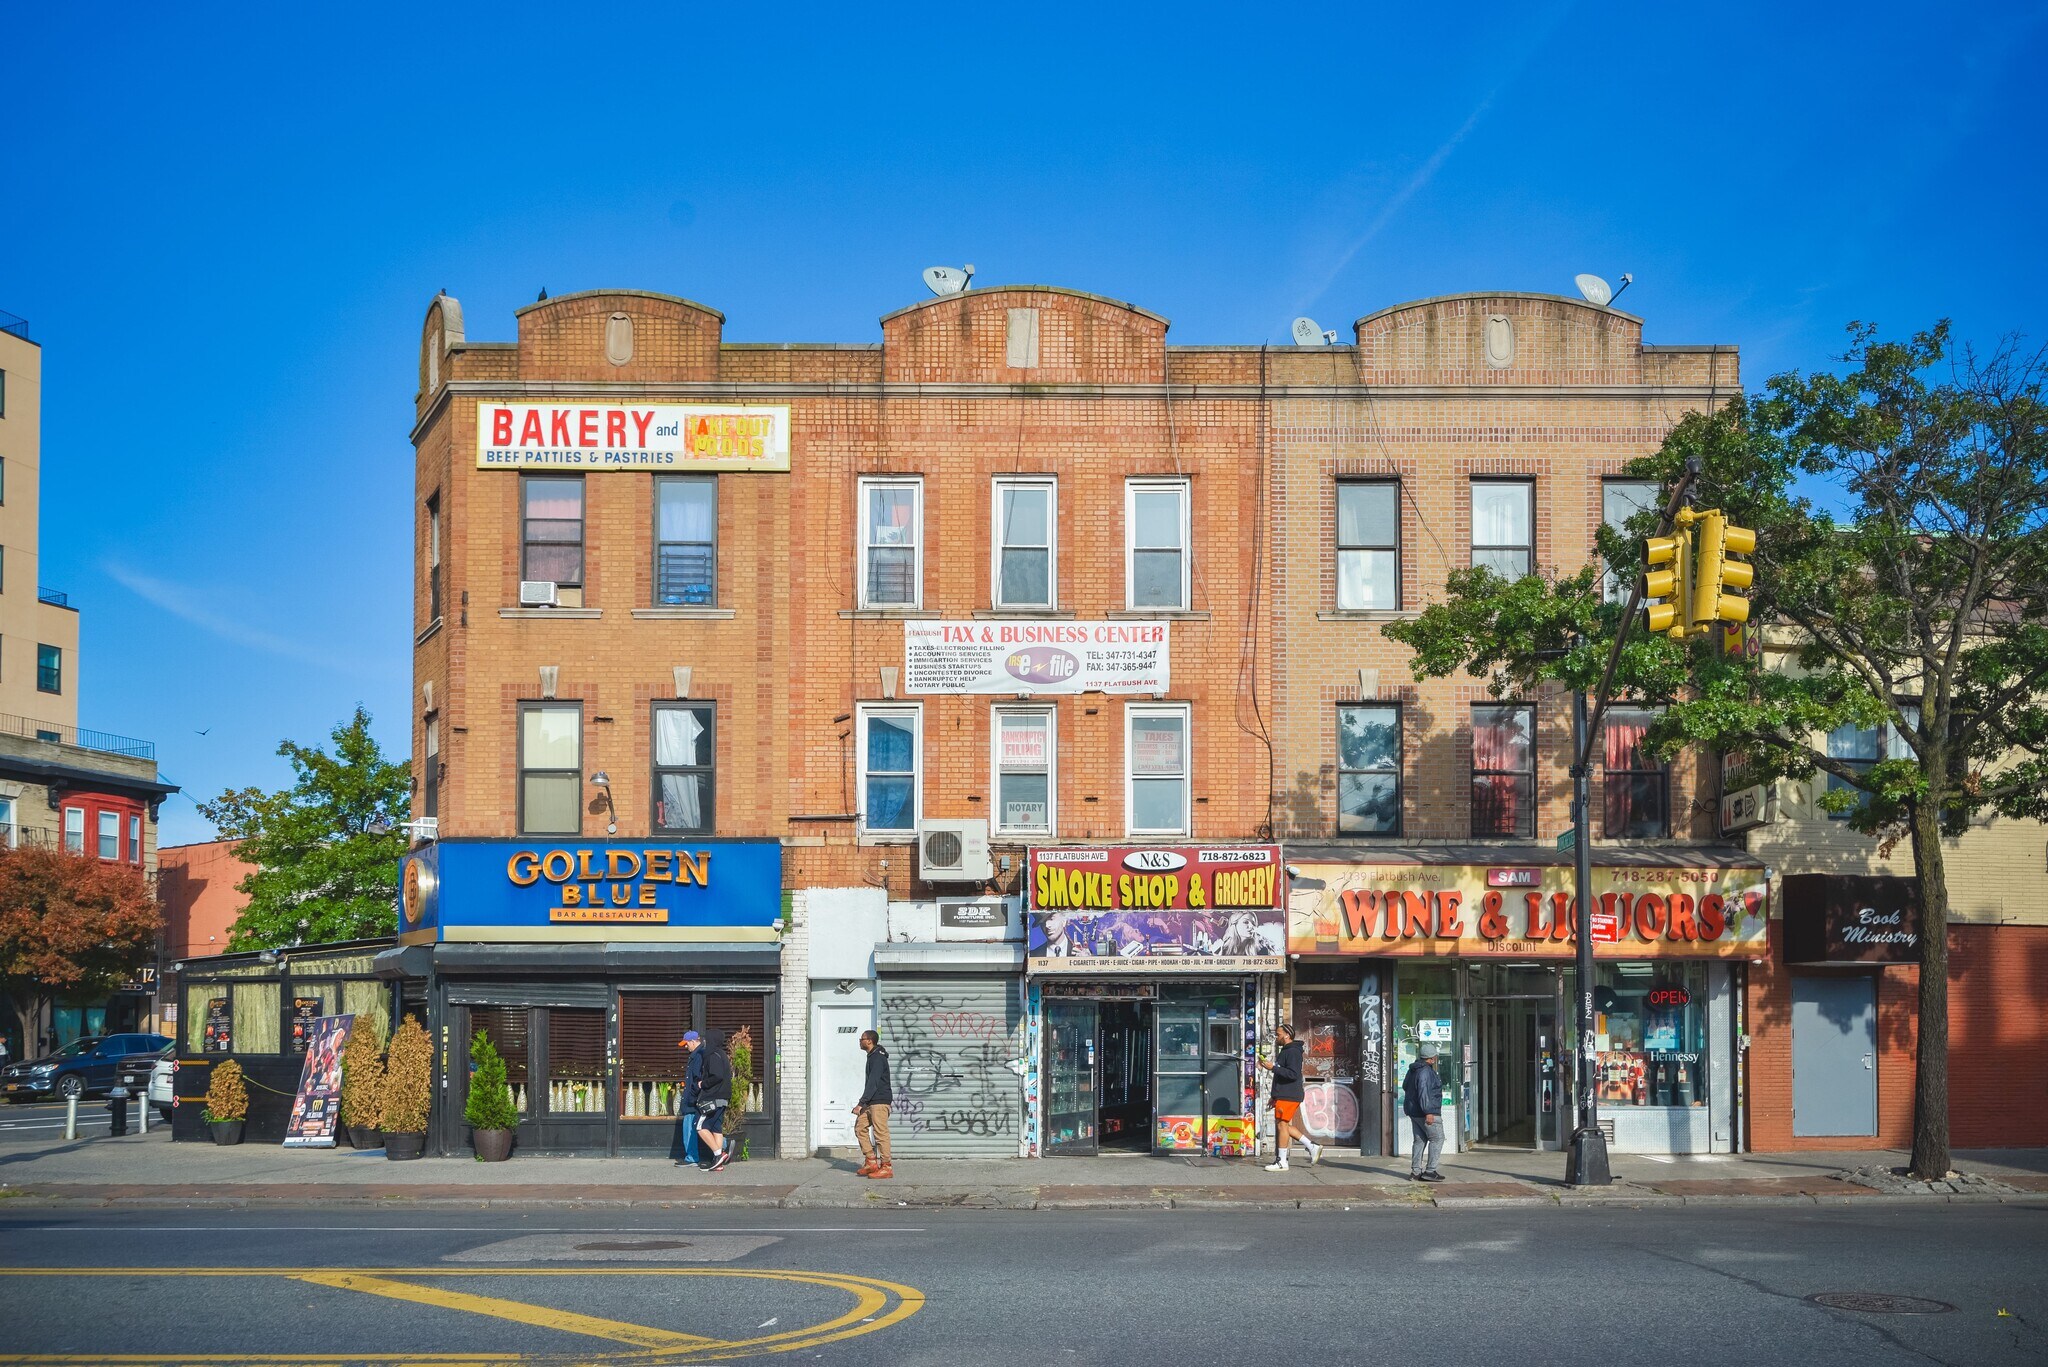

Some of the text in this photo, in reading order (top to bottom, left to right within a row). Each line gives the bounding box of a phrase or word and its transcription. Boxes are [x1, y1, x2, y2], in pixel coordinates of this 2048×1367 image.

[493, 409, 679, 448] BAKERY and
[690, 417, 770, 436] TAKE OUT
[486, 451, 674, 464] BEEF PATTIES & PASTRIES
[941, 626, 974, 642] TAX
[981, 626, 993, 642] &
[1000, 626, 1088, 643] BUSINESS
[1094, 626, 1163, 643] CENTER
[1086, 650, 1157, 660] TEL: 347-731-4347
[1008, 654, 1074, 676] IRS e file
[1086, 661, 1157, 671] FAX: 347-365-9447
[1144, 732, 1174, 741] TAXES
[1005, 744, 1042, 756] FILING
[1009, 804, 1043, 812] NOTARY
[1140, 853, 1171, 868] N&S
[1202, 852, 1267, 861] 718-872-6823
[507, 850, 712, 886] GOLDEN
[1370, 871, 1415, 881] Flatbush
[1418, 872, 1440, 881] Ave.
[1498, 872, 1531, 883] SAM
[1612, 871, 1719, 883] 718-287-5050
[1037, 863, 1276, 907] SMOKE SHOP & GROCERY
[562, 884, 657, 905] BLUE
[958, 907, 991, 916] SDK
[1340, 890, 1464, 938] WINE
[1480, 890, 1510, 940] &
[1859, 908, 1900, 925] Book
[1842, 926, 1917, 948] Ministry
[1488, 940, 1537, 952] Discount
[1650, 991, 1687, 1004] OPEN
[1651, 1051, 1699, 1063] Hennessy
